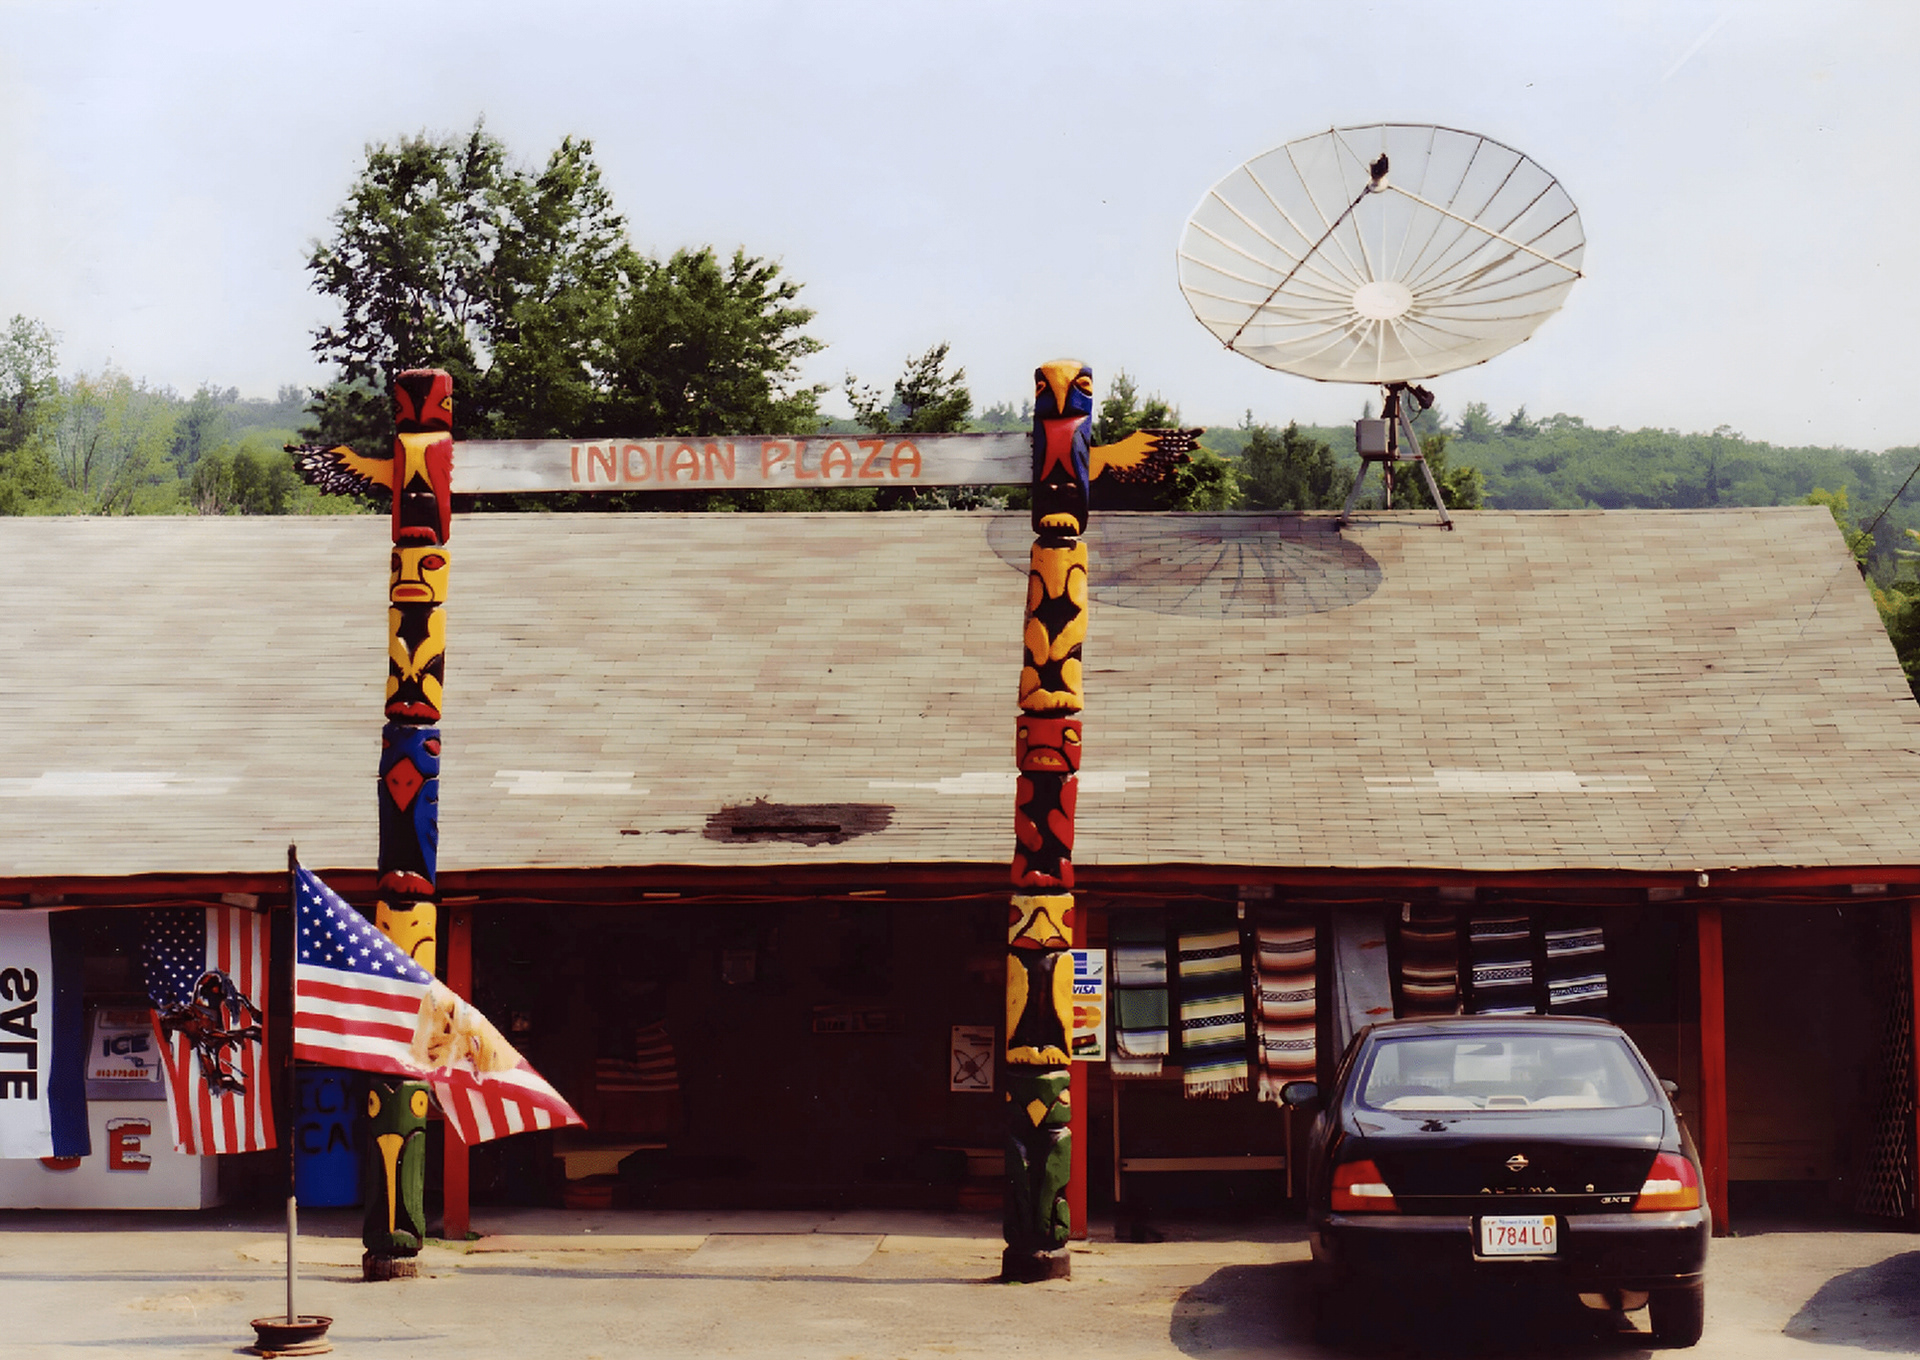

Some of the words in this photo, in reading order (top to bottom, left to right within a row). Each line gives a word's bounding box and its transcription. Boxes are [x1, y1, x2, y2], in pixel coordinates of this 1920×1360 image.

[571, 443, 735, 483] INDIAN
[761, 440, 922, 479] PLAZA
[1073, 985, 1096, 995] VISA
[103, 1033, 150, 1057] ICE
